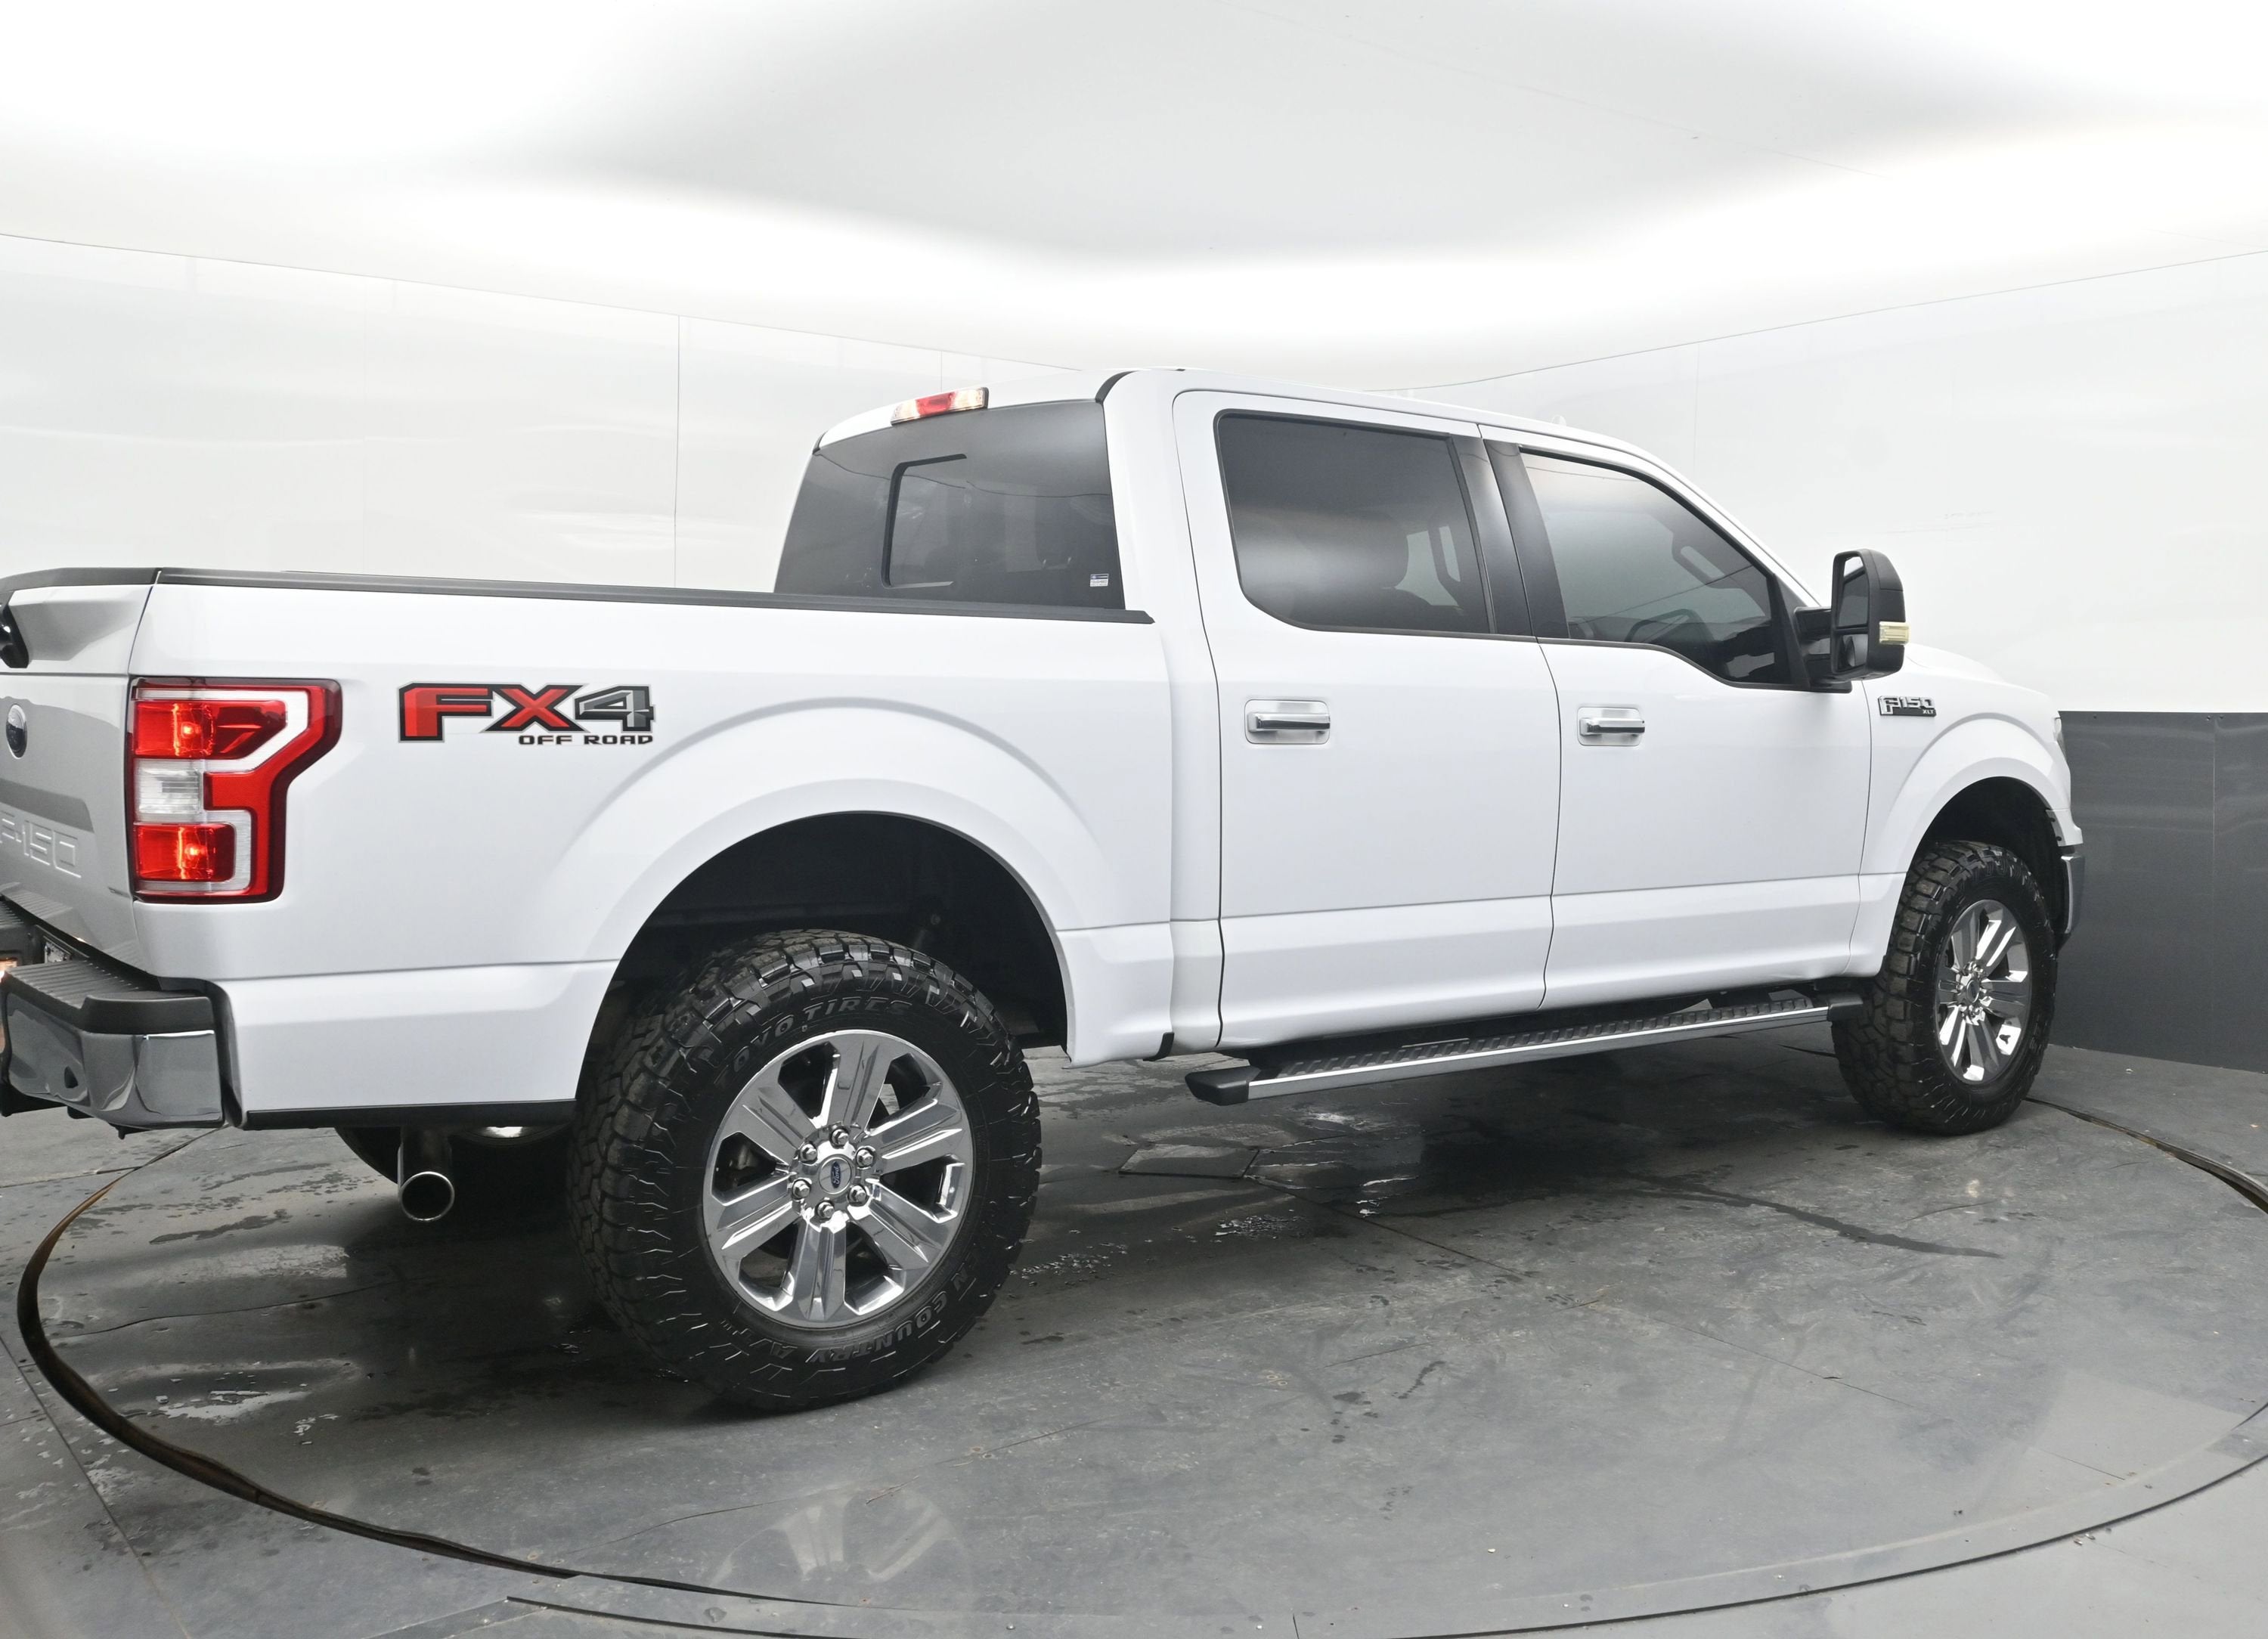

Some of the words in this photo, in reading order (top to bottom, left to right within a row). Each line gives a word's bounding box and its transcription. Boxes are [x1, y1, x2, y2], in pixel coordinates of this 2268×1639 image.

[398, 682, 656, 742] FX4
[1877, 696, 1935, 715] F150
[518, 735, 572, 745] OFF
[584, 735, 653, 745] ROAD
[805, 1290, 947, 1363] COUNTRY
